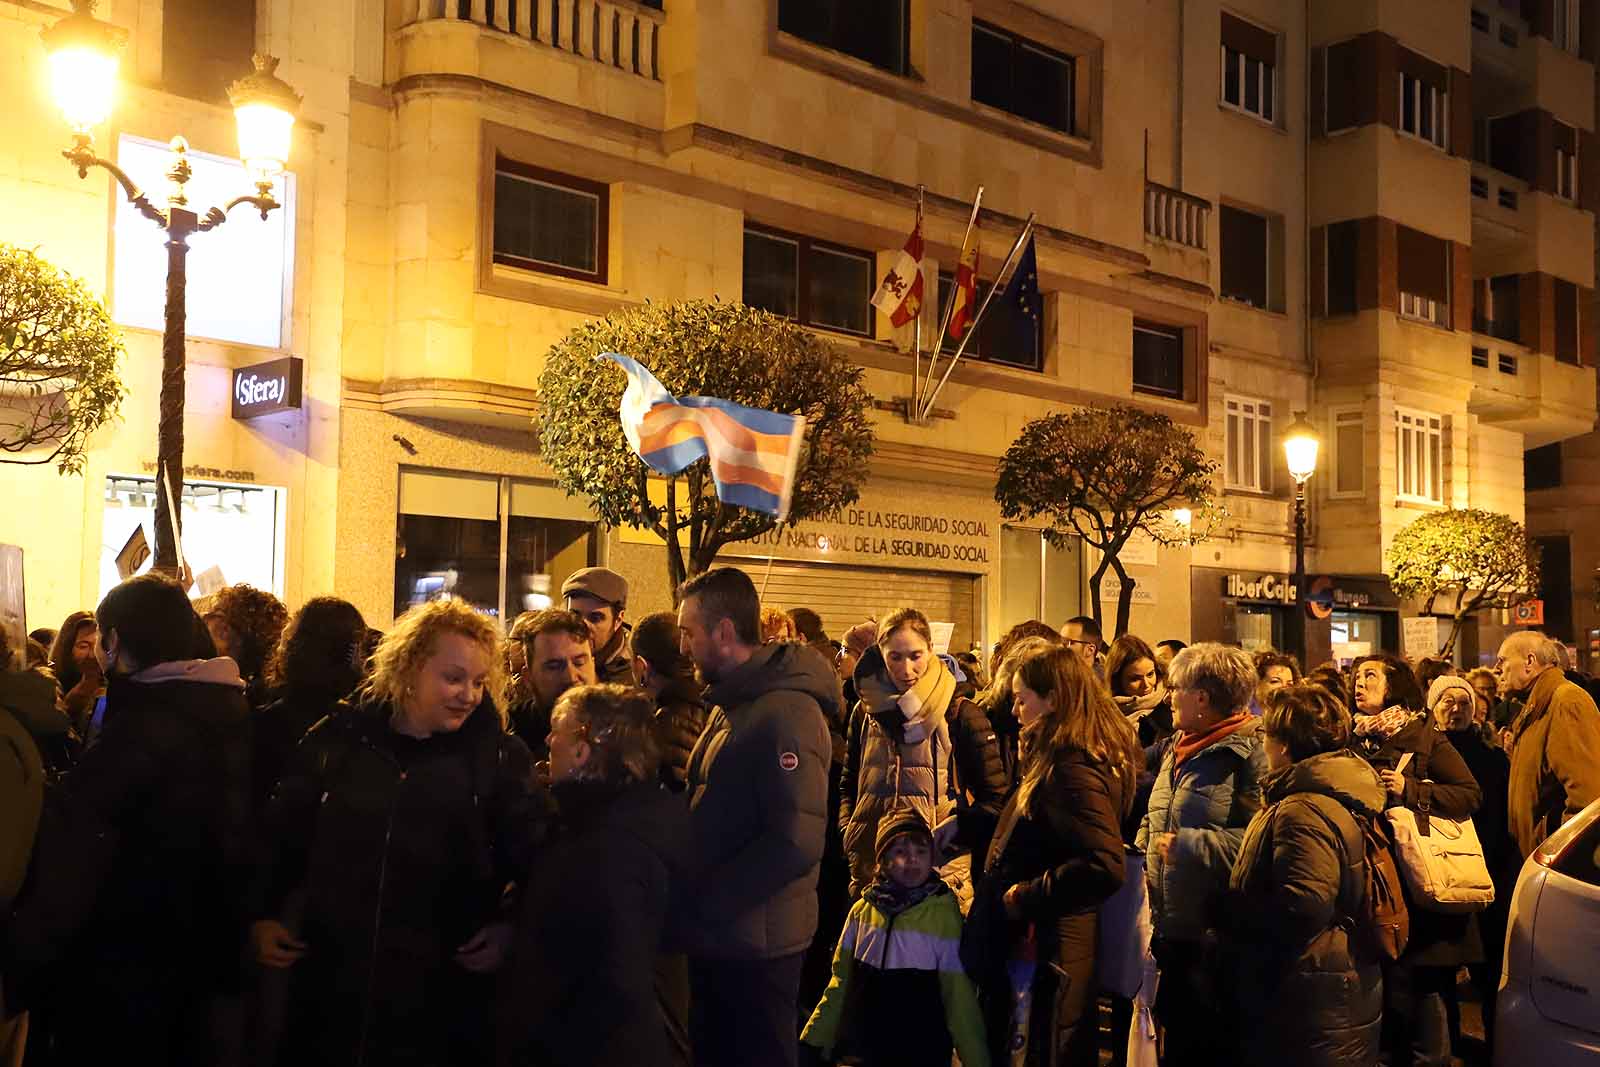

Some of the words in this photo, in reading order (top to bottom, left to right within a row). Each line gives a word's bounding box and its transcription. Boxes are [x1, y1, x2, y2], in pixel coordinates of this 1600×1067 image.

[235, 372, 285, 406] (sfera)
[849, 509, 864, 526] DE
[867, 511, 882, 528] LA
[885, 513, 948, 533] SEGURIDAD
[951, 519, 989, 537] SOCIAL
[854, 536, 869, 553] DE
[872, 537, 888, 554] LA
[891, 539, 950, 560] SEGURIDAD
[953, 544, 989, 563] SOCIAL
